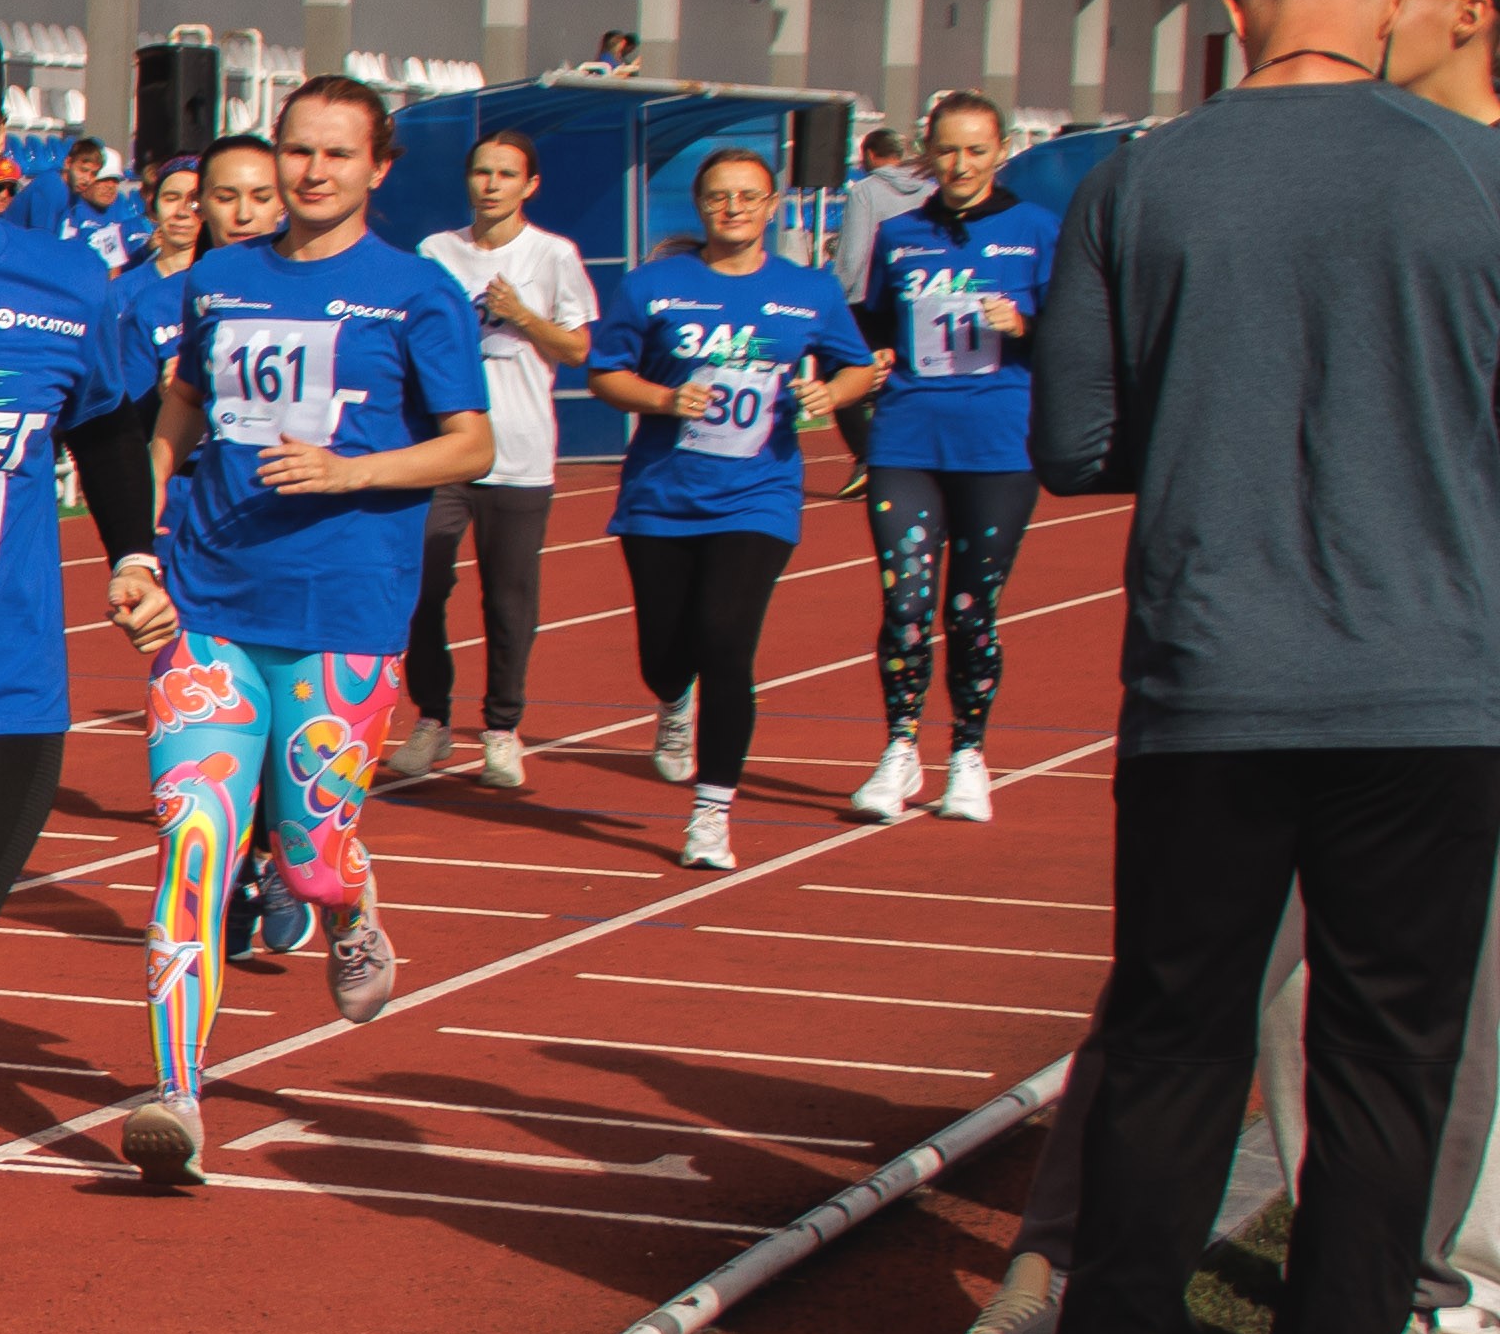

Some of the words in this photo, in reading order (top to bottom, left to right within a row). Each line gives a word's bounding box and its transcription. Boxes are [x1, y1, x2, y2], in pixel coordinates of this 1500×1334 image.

[16, 312, 86, 338] РОСАТОМ
[931, 311, 979, 352] 11
[230, 345, 306, 403] 161
[703, 383, 761, 430] 30
